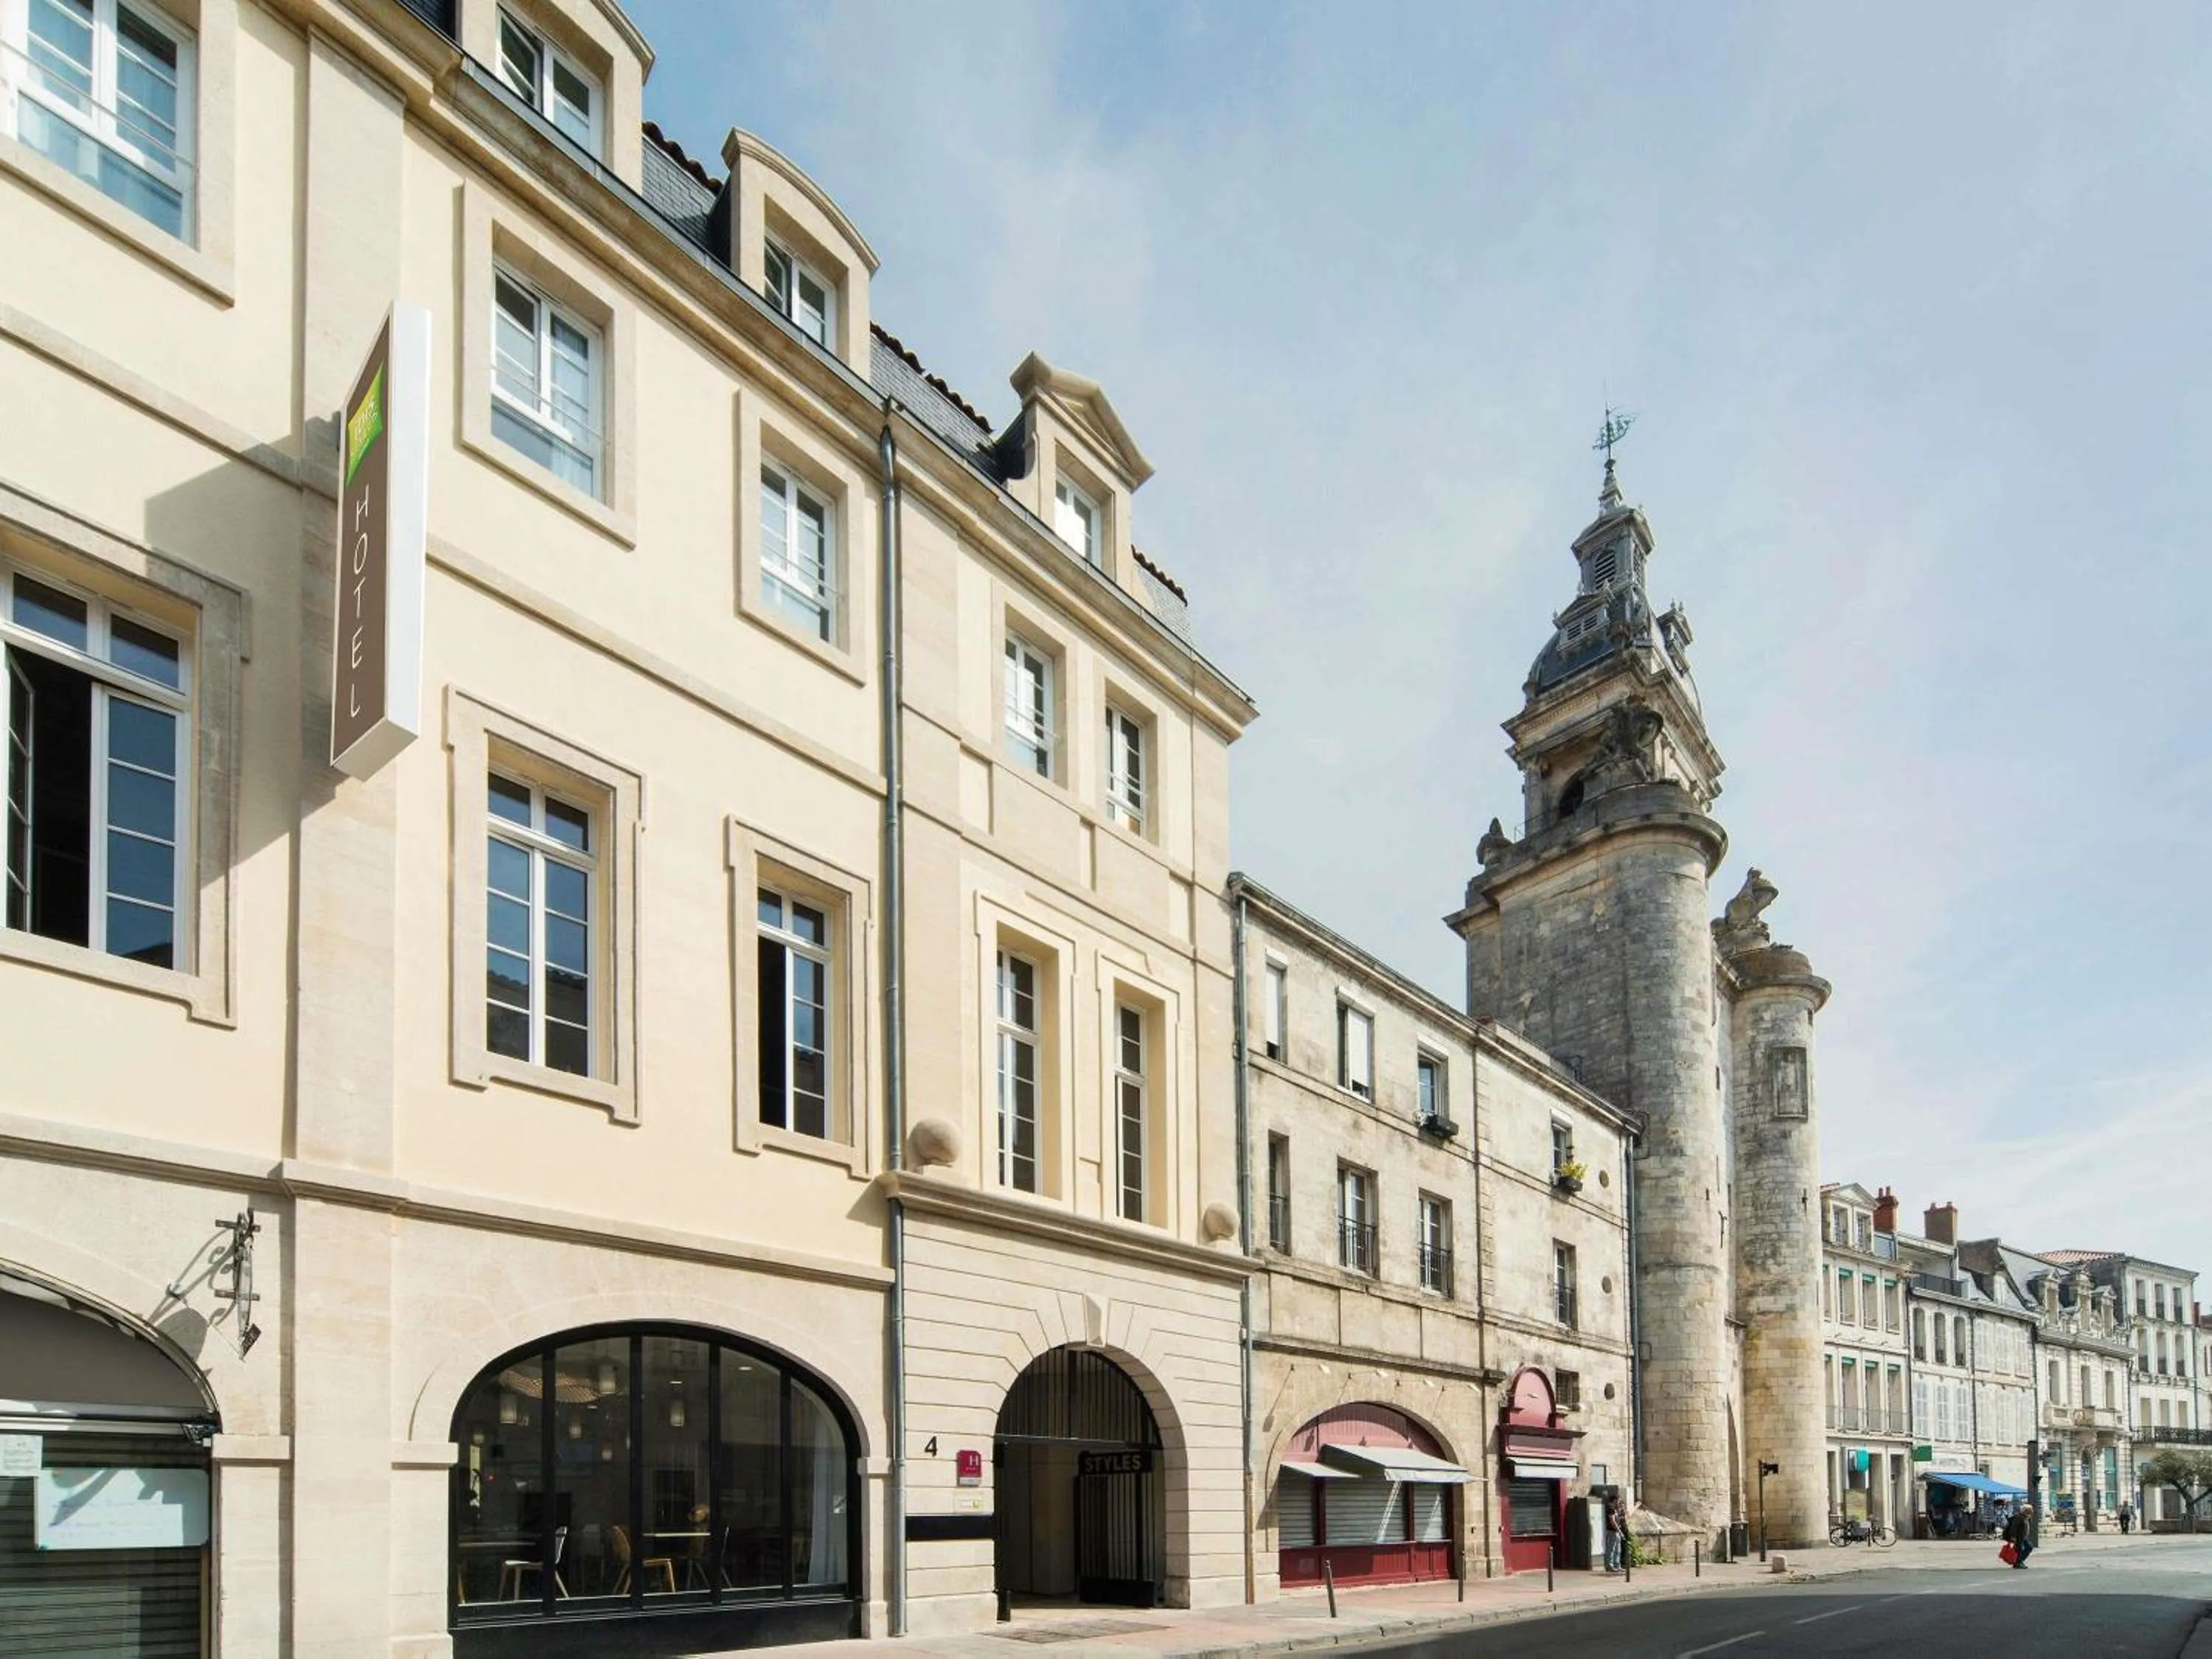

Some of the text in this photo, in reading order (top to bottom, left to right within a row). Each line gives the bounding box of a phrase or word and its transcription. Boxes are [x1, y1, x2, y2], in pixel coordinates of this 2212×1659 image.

[349, 484, 369, 718] HOTEL
[924, 1436, 937, 1457] 4
[969, 1455, 979, 1467] H
[1085, 1454, 1141, 1472] STYLES
